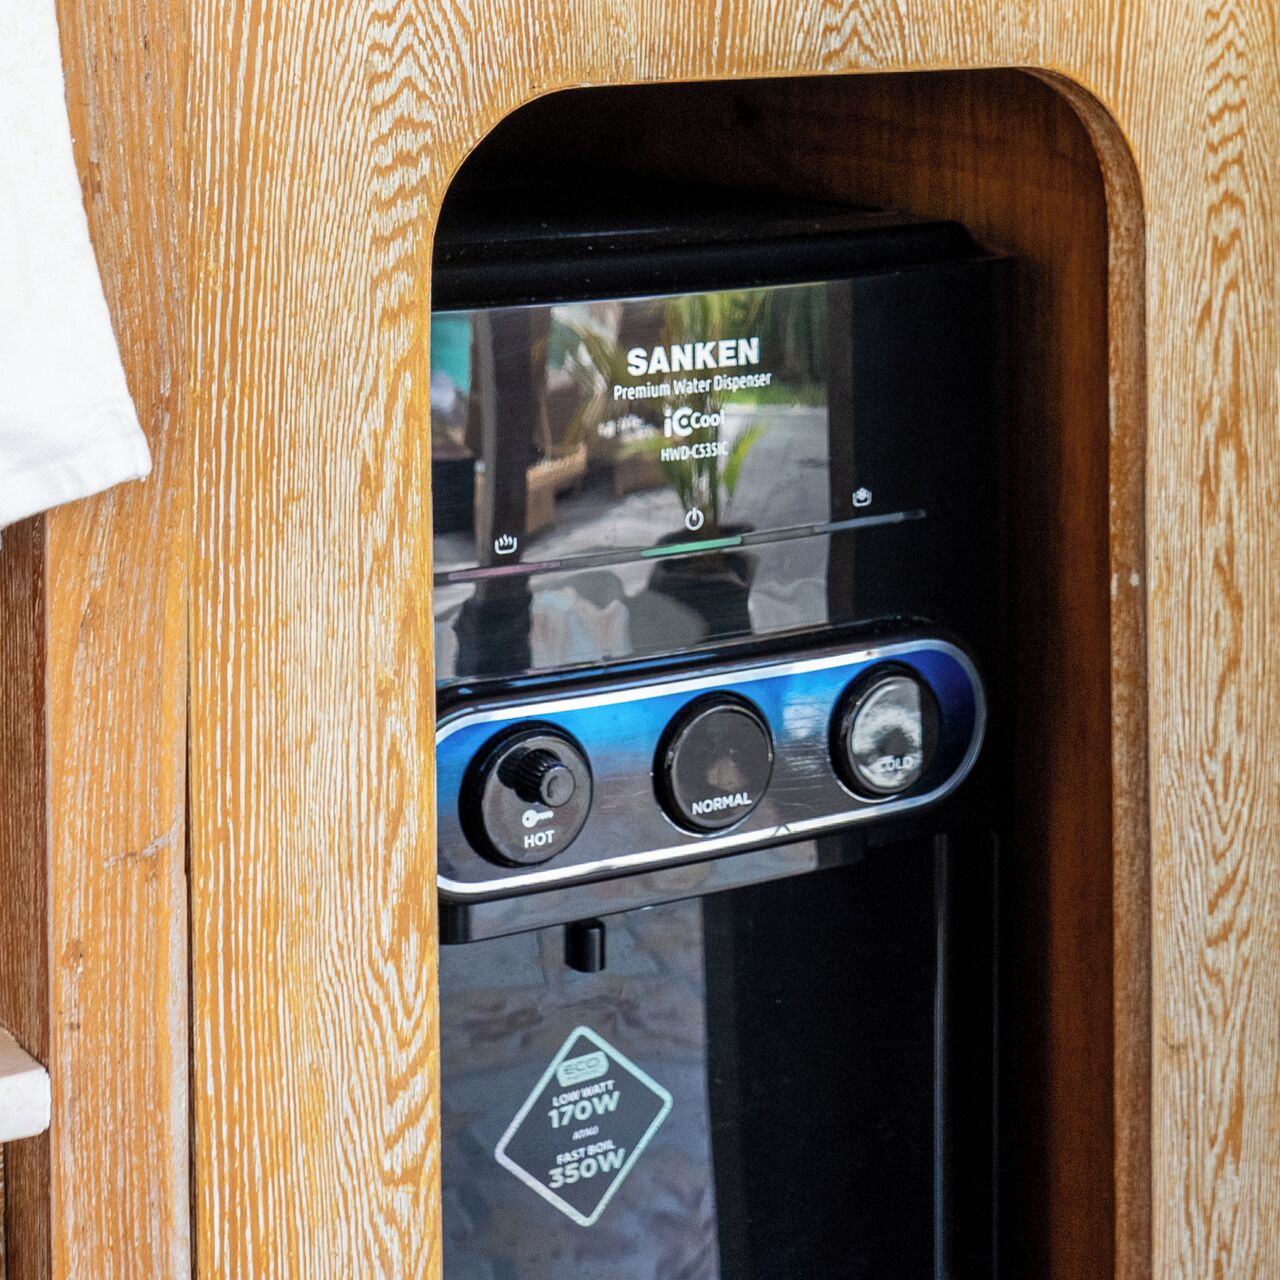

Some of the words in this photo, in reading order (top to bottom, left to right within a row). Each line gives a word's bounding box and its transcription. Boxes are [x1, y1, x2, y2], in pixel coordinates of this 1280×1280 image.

[626, 336, 760, 377] SANKEN
[613, 381, 671, 401] Premium
[673, 377, 712, 396] Water
[714, 372, 772, 393] Dispenser
[877, 755, 914, 772] COLD
[692, 792, 752, 815] NORMAL
[524, 830, 555, 848] HOT
[552, 1089, 580, 1107] LOW
[581, 1080, 615, 1098] WATT
[548, 1091, 620, 1128] 170W
[556, 1147, 586, 1165] FAST
[586, 1139, 616, 1156] BOIL
[548, 1147, 626, 1188] 350W
